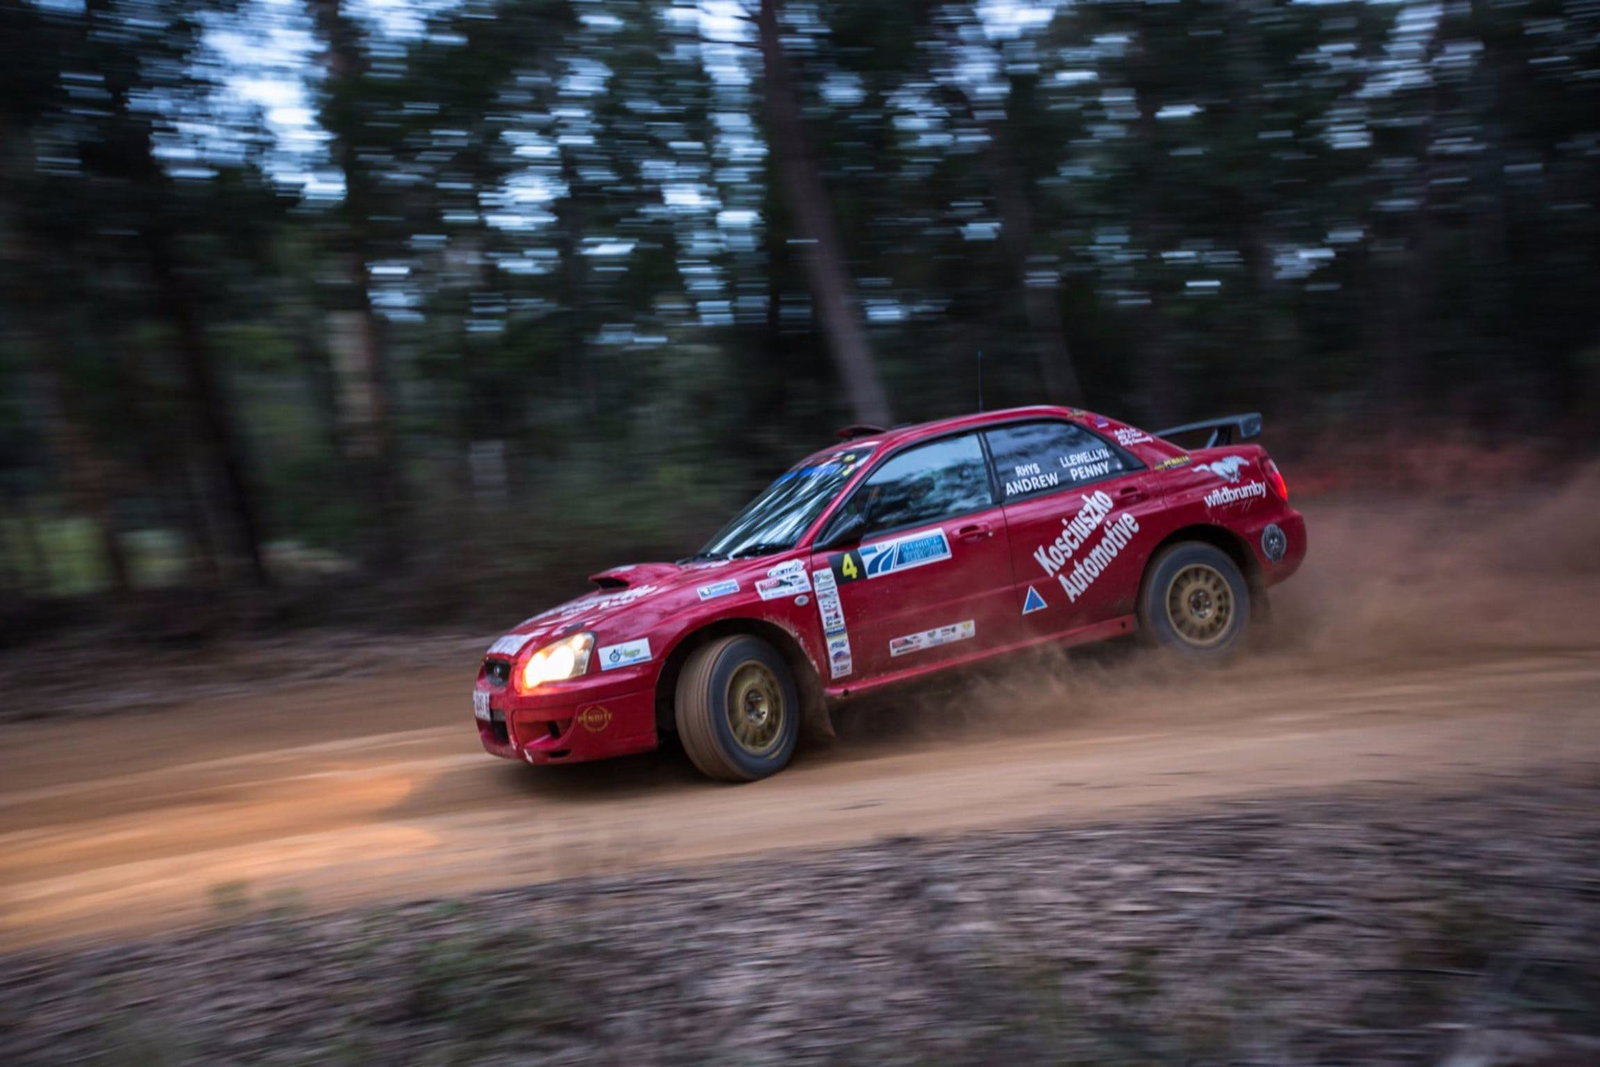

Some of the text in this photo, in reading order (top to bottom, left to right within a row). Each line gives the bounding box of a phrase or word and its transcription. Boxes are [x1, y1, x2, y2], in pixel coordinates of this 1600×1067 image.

[1005, 461, 1110, 496] ANDREW PENNY
[1015, 448, 1110, 477] RHYS LLEWELLYN
[1203, 480, 1267, 507] wildbrumby
[1033, 490, 1114, 578] Kosciuszko
[842, 553, 858, 579] 4
[1058, 512, 1140, 603] Automotive
